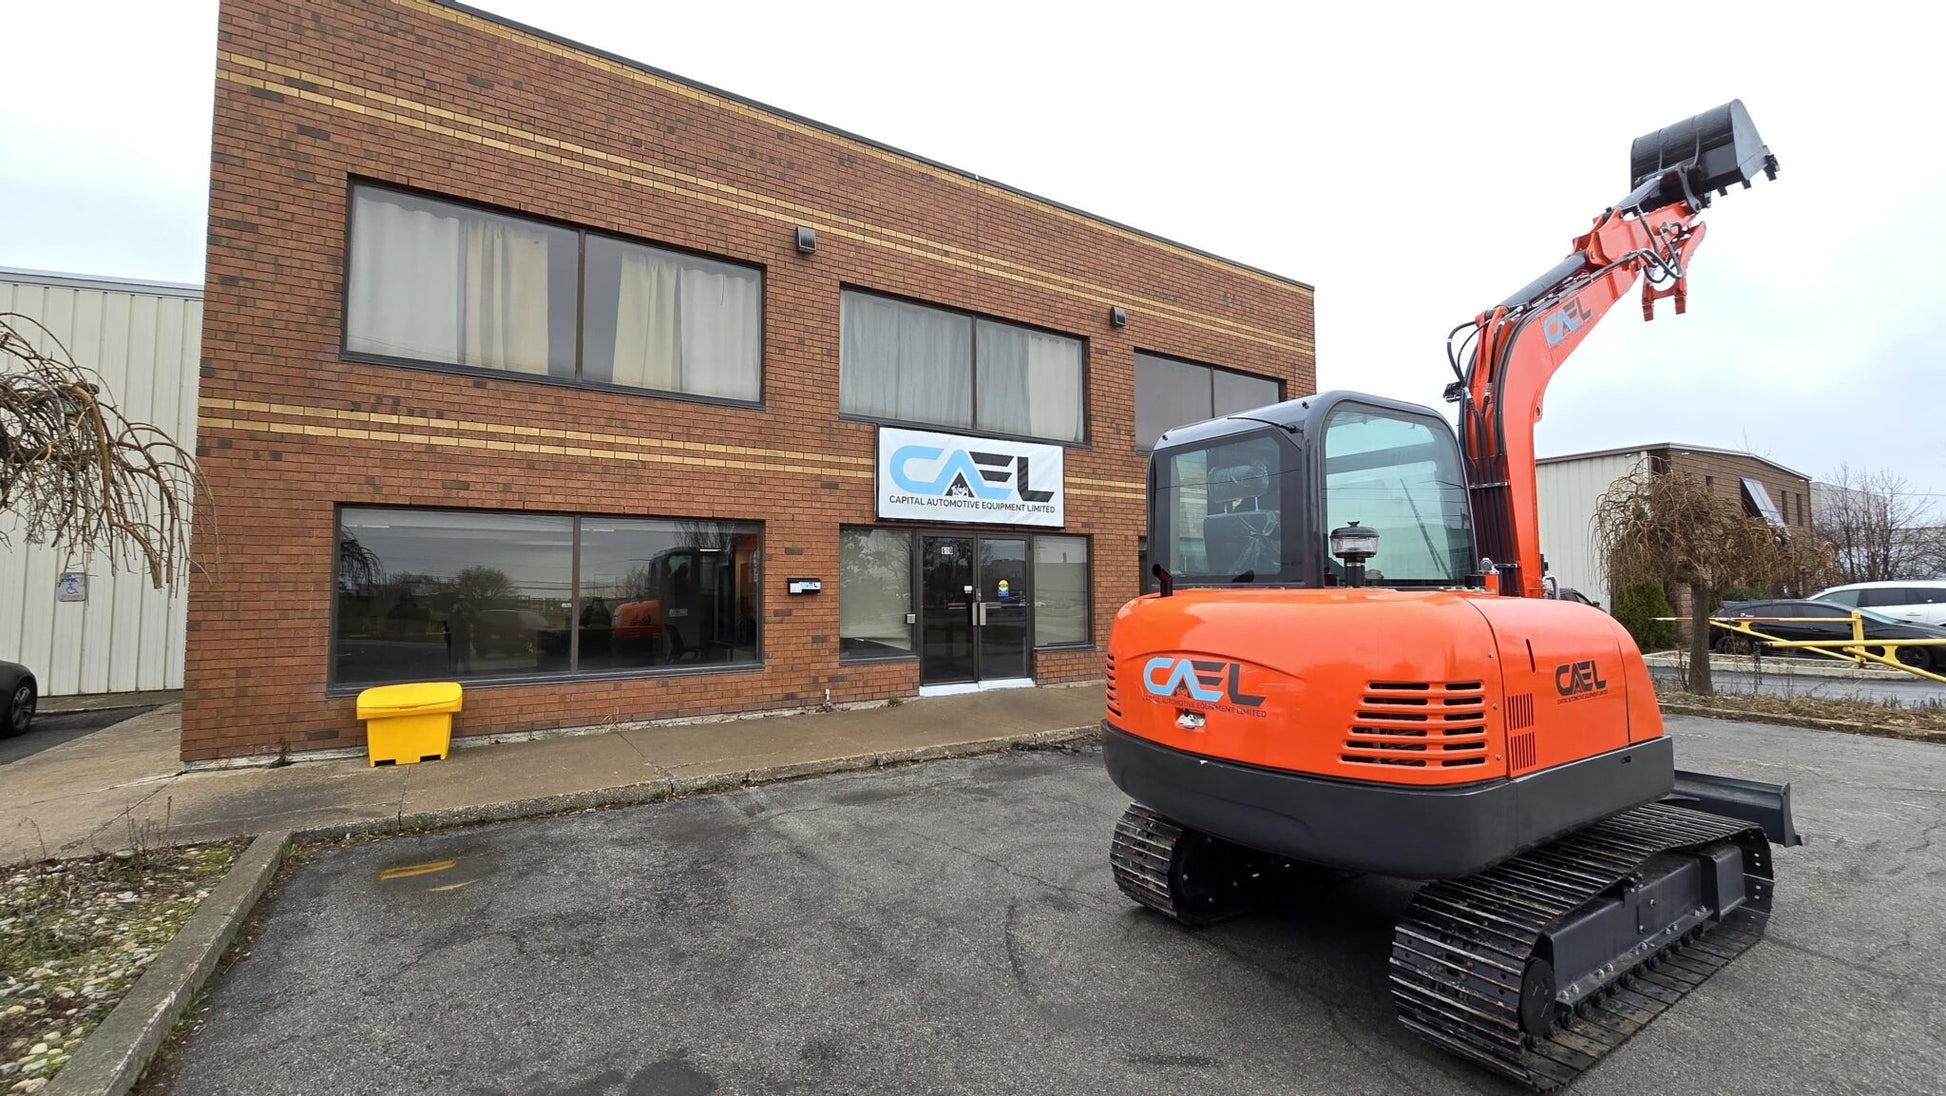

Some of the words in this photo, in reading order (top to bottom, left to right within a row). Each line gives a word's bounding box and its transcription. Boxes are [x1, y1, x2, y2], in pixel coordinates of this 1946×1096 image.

[1543, 296, 1592, 344] CAEL
[889, 445, 1055, 503] CAEL
[889, 495, 925, 506] CAPITAL
[926, 498, 980, 509] AUTOMOTIVE
[981, 501, 1024, 512] EQUIPMENT
[1027, 503, 1055, 514] LIMITED
[1143, 656, 1267, 707] CAEL
[1555, 660, 1606, 696] CAEL
